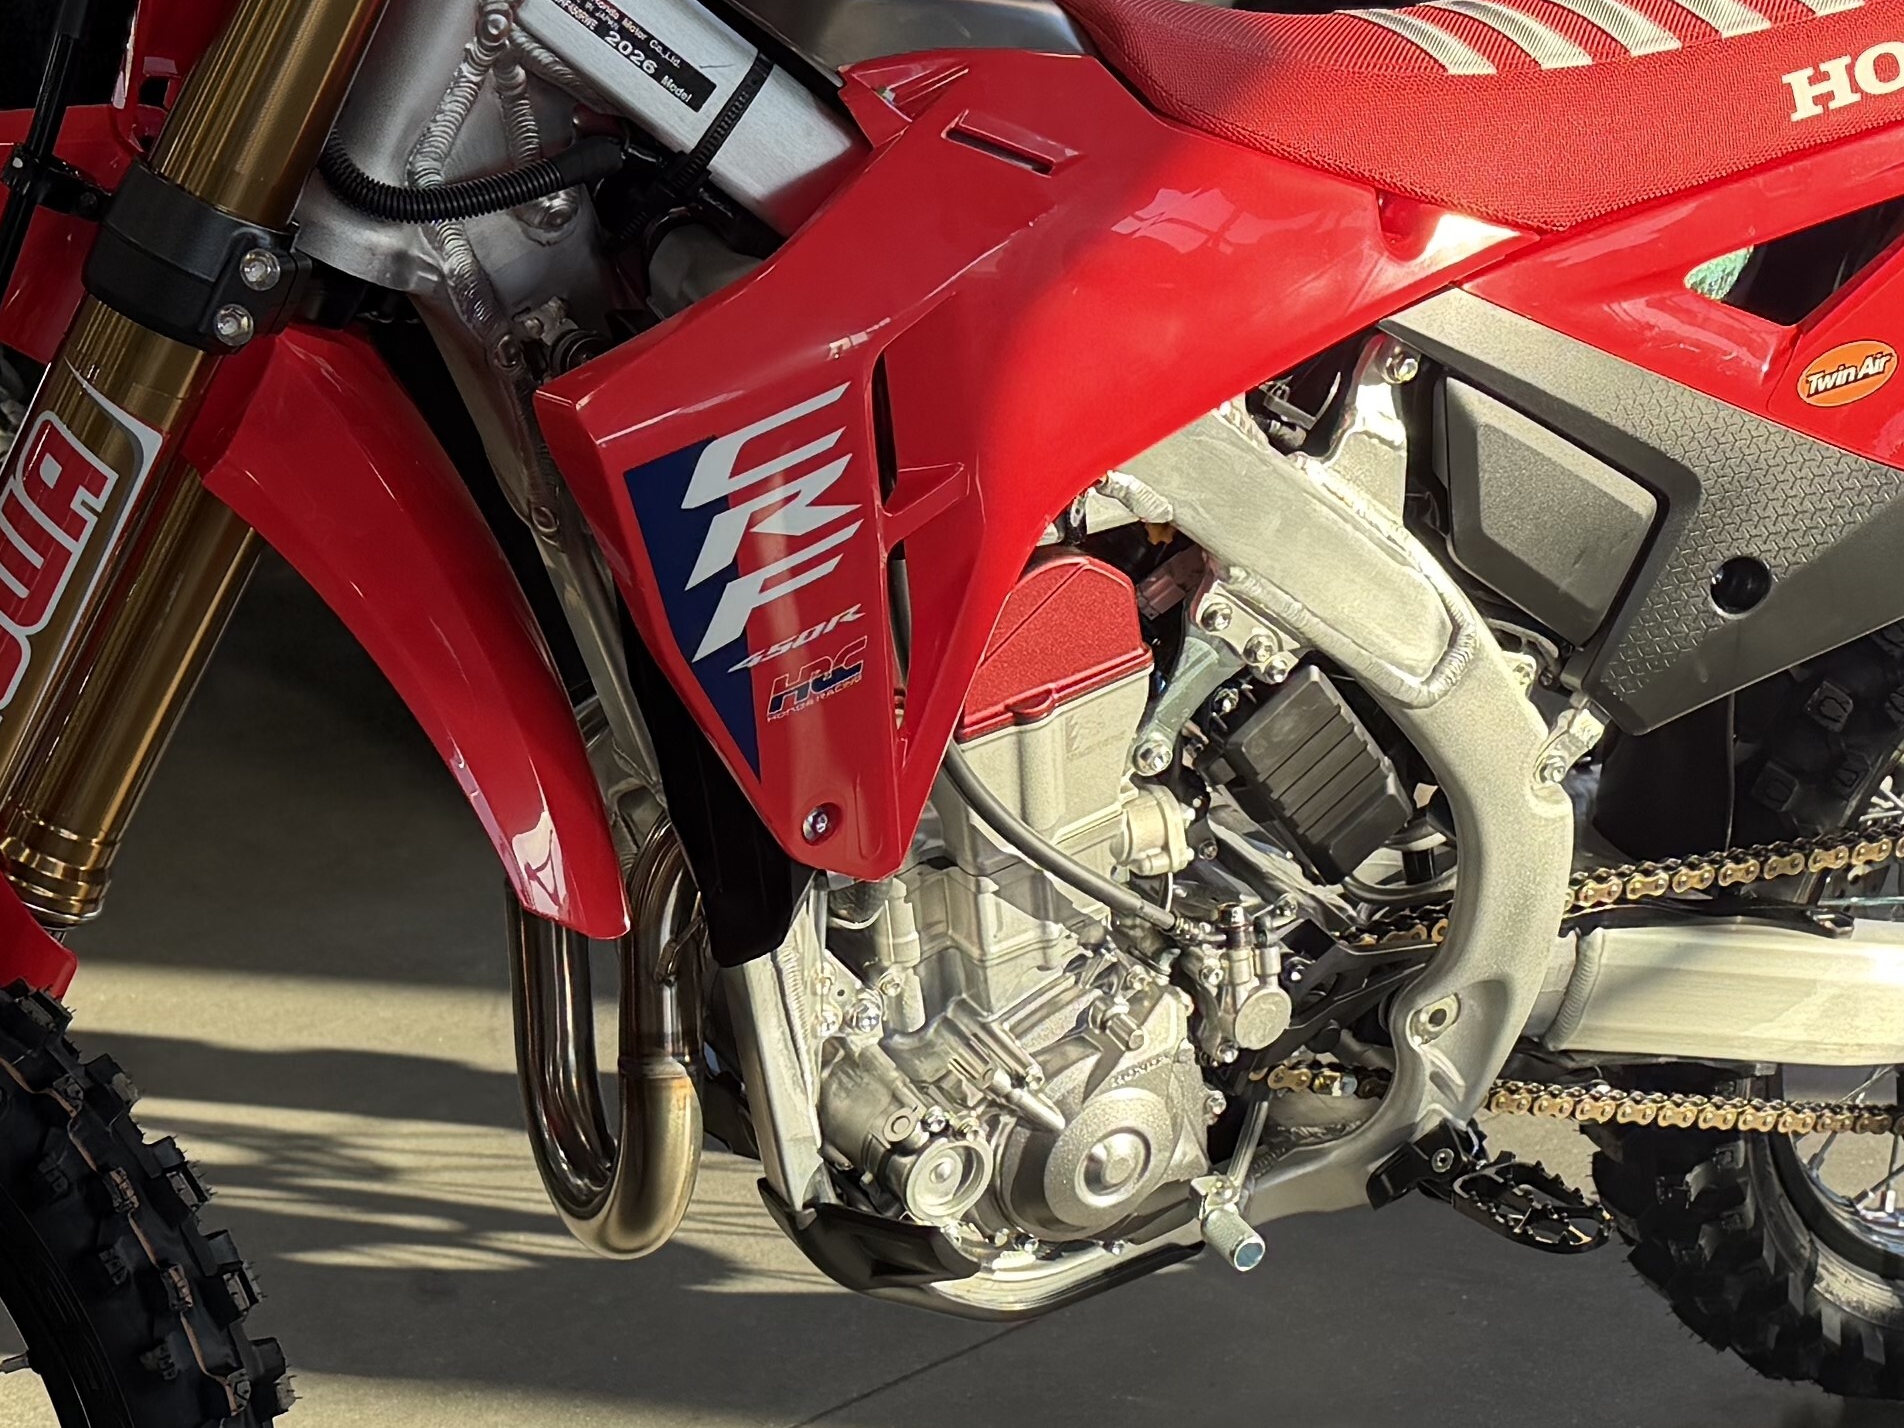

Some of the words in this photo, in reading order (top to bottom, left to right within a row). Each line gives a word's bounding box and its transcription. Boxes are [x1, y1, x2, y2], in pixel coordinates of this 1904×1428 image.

[620, 17, 648, 41] Motor
[603, 29, 659, 76] 2026
[659, 74, 693, 103] Model
[1805, 364, 1858, 398] Twin
[1857, 351, 1893, 381] Air
[682, 381, 864, 663] CRF
[727, 603, 866, 673] 450R
[767, 635, 868, 716] HRC
